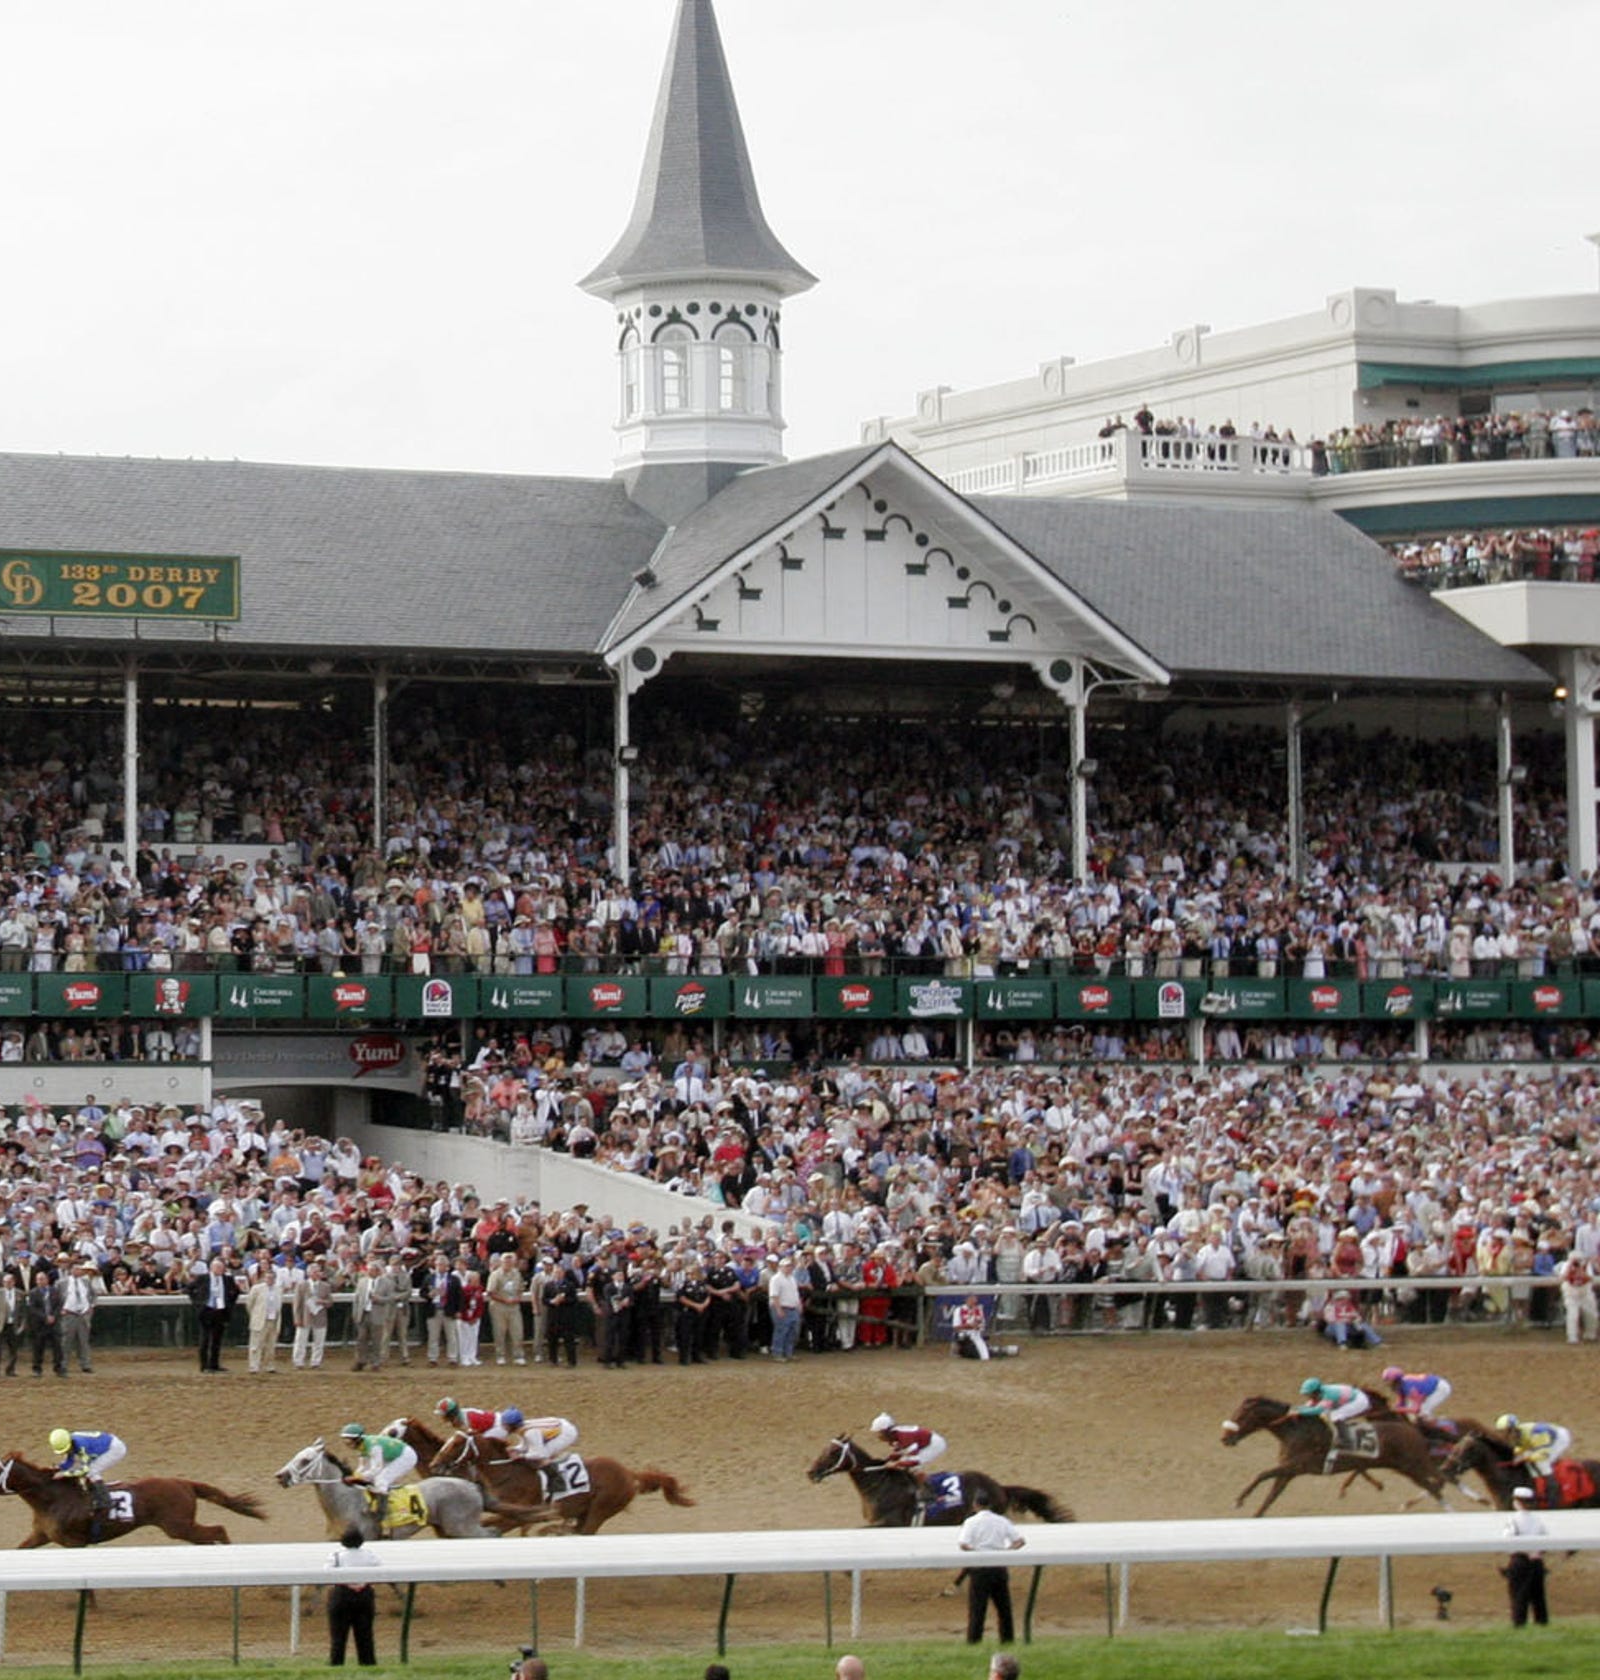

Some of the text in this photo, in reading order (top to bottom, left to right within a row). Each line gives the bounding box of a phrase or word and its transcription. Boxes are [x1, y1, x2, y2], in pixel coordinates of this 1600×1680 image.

[128, 566, 221, 585] DERBY
[72, 582, 206, 610] 2007
[66, 987, 98, 1001] Yum!
[336, 988, 366, 1002] Yum!
[592, 988, 622, 1001] Yum!
[842, 990, 870, 1003] Yum!
[1081, 991, 1109, 1003] Yum!
[353, 1043, 401, 1062] Yum!
[566, 1460, 586, 1490] 2
[942, 1475, 962, 1503] 3
[410, 1494, 426, 1519] 4
